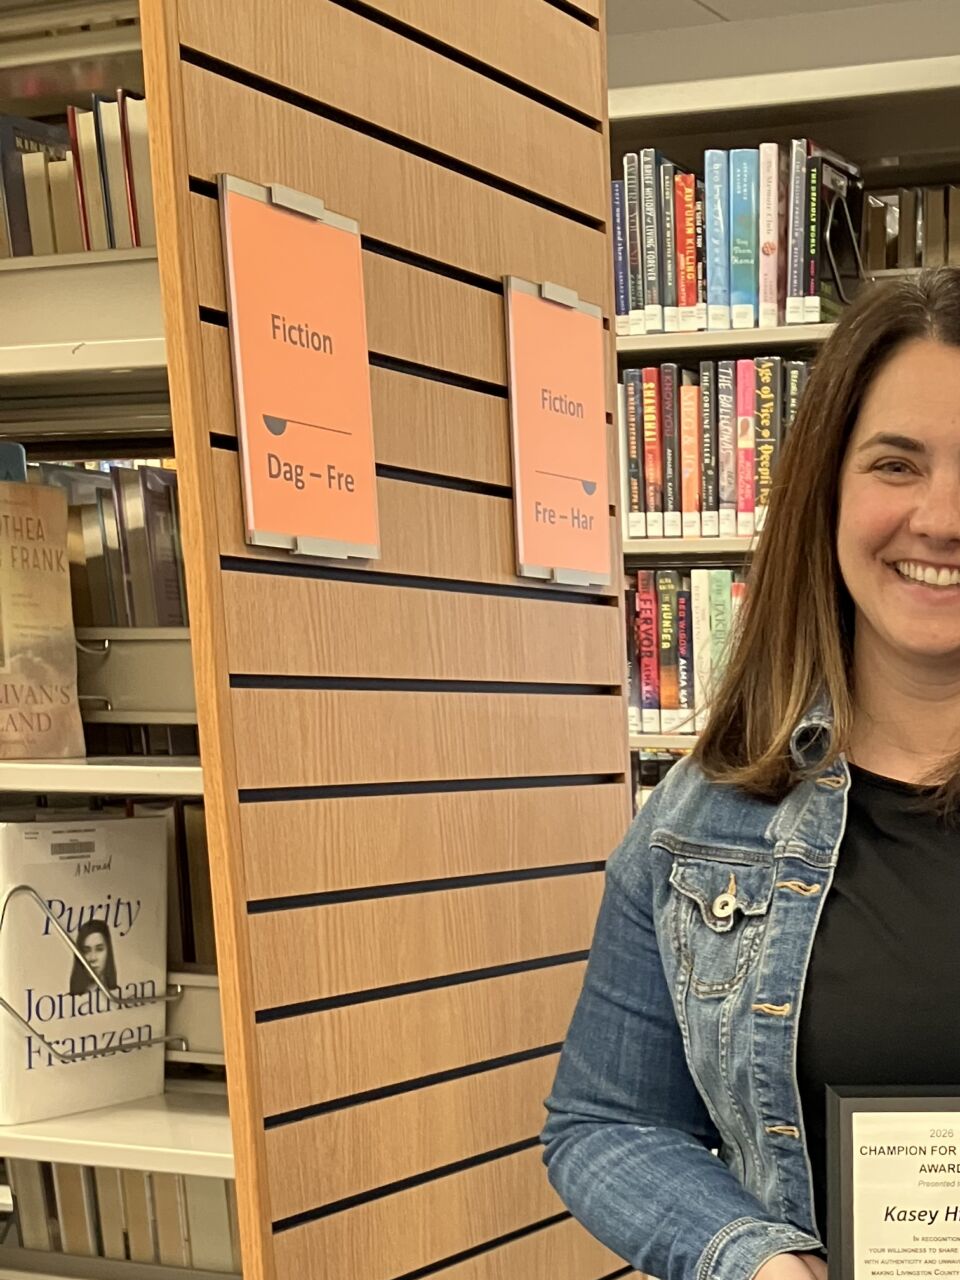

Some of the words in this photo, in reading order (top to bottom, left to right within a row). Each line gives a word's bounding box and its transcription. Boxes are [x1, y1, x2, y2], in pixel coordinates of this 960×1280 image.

[645, 187, 654, 216] HISTORY
[684, 187, 695, 235] AUTUMN
[645, 225, 655, 248] LIVING
[646, 251, 657, 281] FOREVER
[685, 238, 696, 281] KILLING
[270, 313, 333, 355] Fiction
[702, 371, 710, 387] THE
[719, 367, 733, 392] THE
[759, 360, 775, 384] Age
[541, 388, 584, 419] Fiction
[760, 386, 775, 399] of
[643, 382, 657, 442] SHANGHAI
[702, 390, 711, 429] FORTUNE
[760, 401, 775, 427] Vice
[703, 433, 711, 465] SELLER
[758, 444, 775, 484] Deepti
[267, 453, 305, 490] Dag
[327, 464, 355, 492] Fre
[0, 514, 45, 541] THEA
[535, 501, 556, 525] Fre
[571, 507, 595, 531] Har
[11, 545, 66, 573] FRANK
[679, 597, 687, 617] RED
[640, 598, 654, 658] FERVOR
[661, 604, 673, 649] HUNGER
[679, 620, 687, 656] WIDOW
[679, 657, 688, 687] ALMA
[0, 684, 71, 705] IVAN'S
[42, 894, 141, 936] Purity
[24, 979, 157, 1023] Jonathan
[24, 1024, 154, 1071] Franzen
[860, 1145, 927, 1156] CHAMPION
[931, 1145, 957, 1156] FOR
[884, 1206, 939, 1225] Kasey
